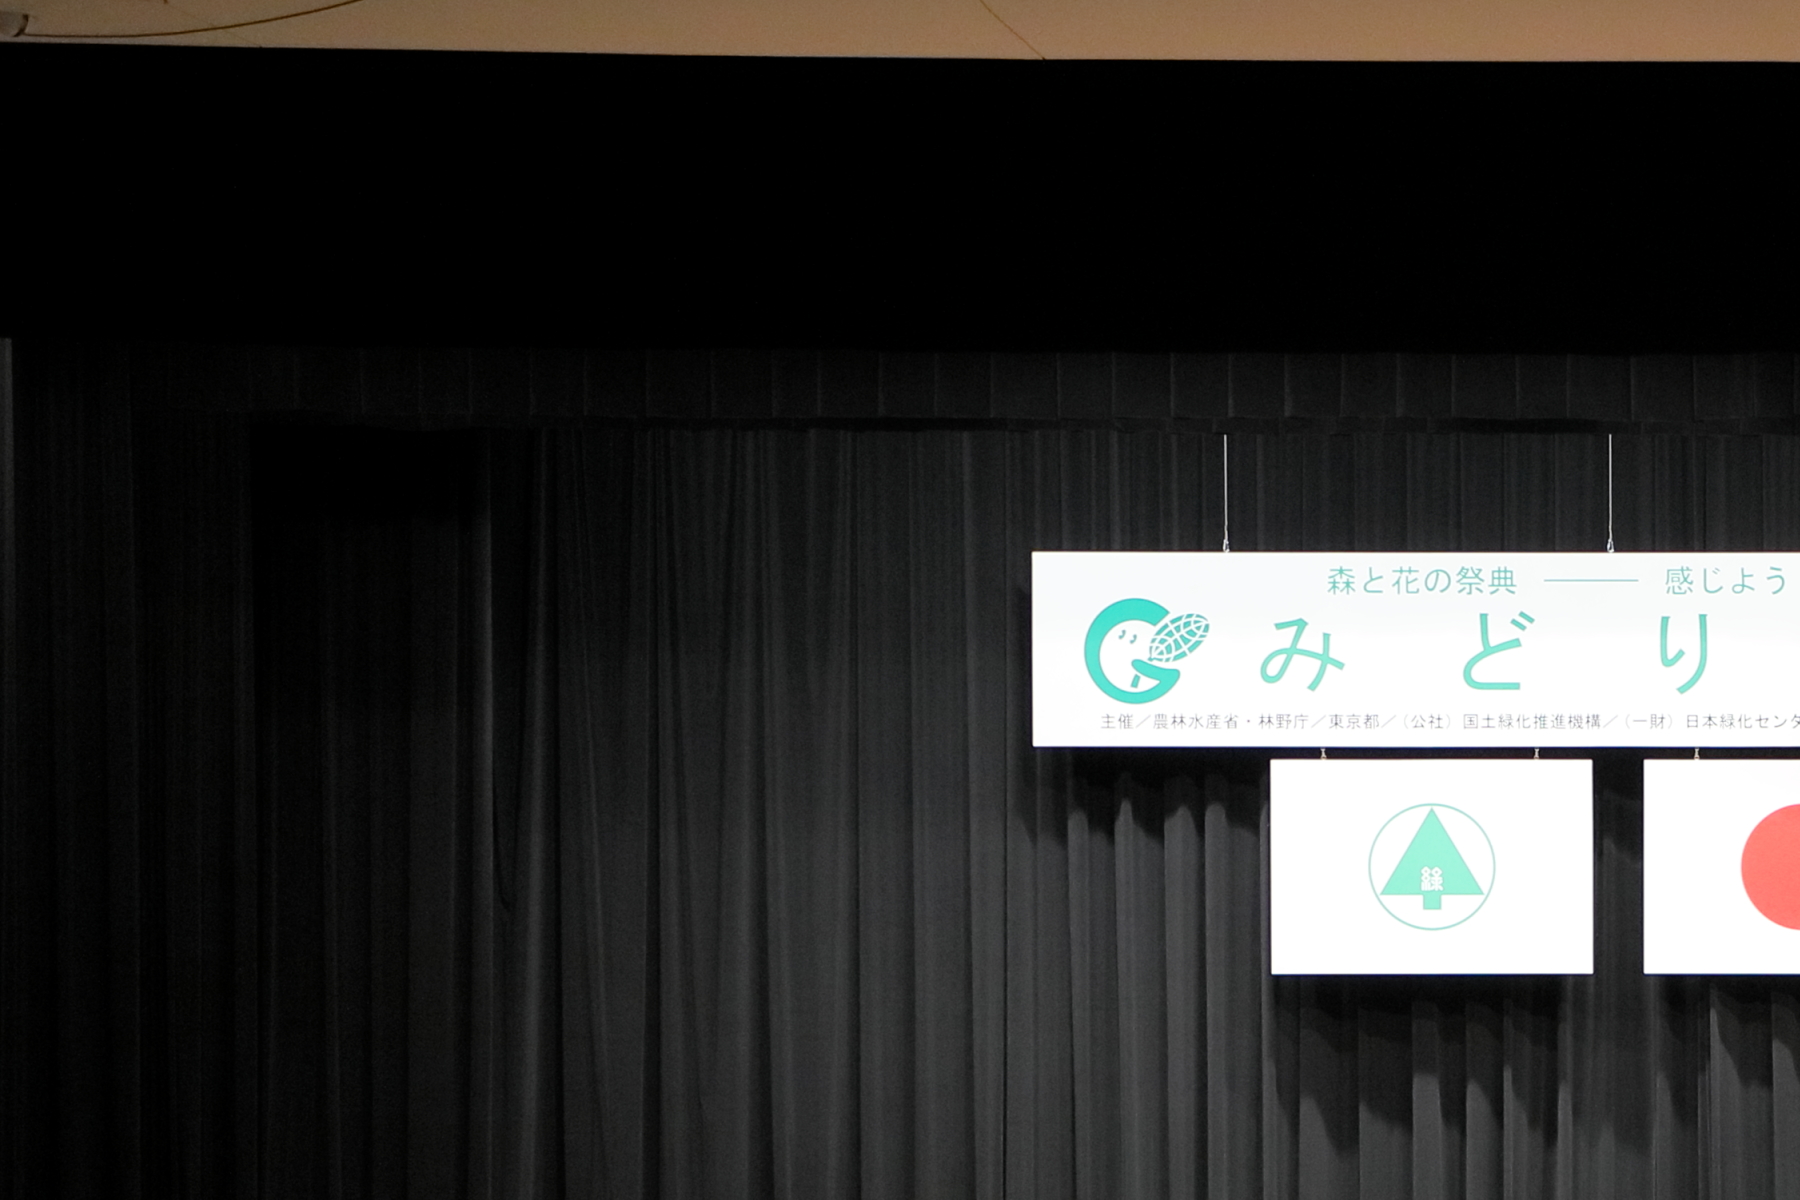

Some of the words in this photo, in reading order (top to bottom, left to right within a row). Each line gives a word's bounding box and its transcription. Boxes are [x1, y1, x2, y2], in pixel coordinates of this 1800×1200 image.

[1328, 566, 1517, 595] 森と花の祭典
[1665, 566, 1785, 595] 感じよう
